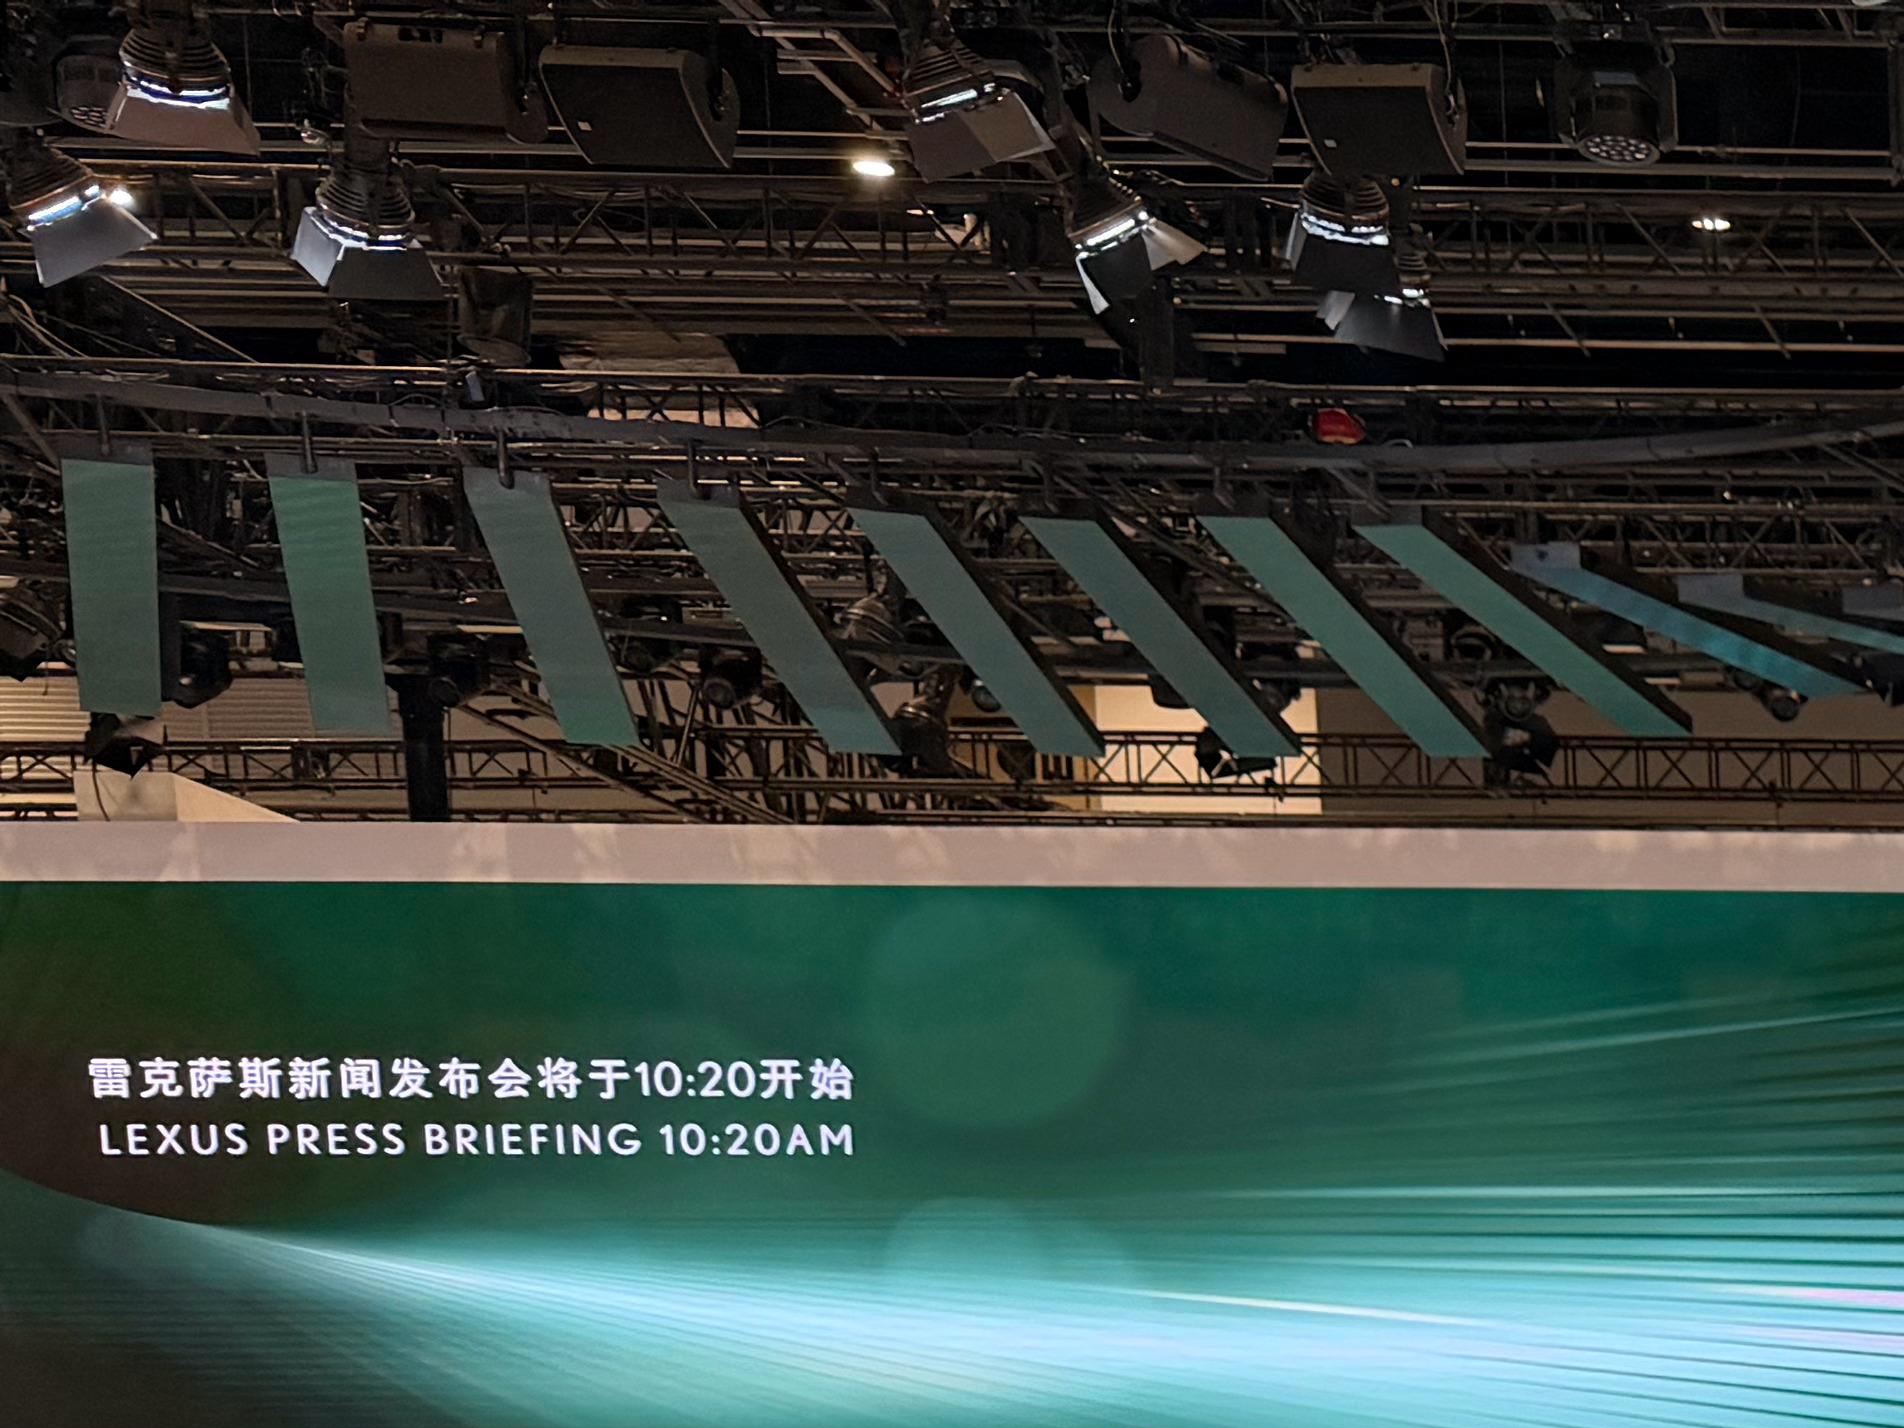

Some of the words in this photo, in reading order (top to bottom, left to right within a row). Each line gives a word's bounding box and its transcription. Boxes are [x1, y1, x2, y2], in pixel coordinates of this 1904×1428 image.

[88, 1056, 854, 1100] 雷克萨斯新闻发布会将于10:20开始
[100, 1123, 249, 1156] LEXUS
[267, 1123, 406, 1156] PRESS
[424, 1123, 642, 1156] BRIEFING
[659, 1123, 854, 1156] 10:20AM
